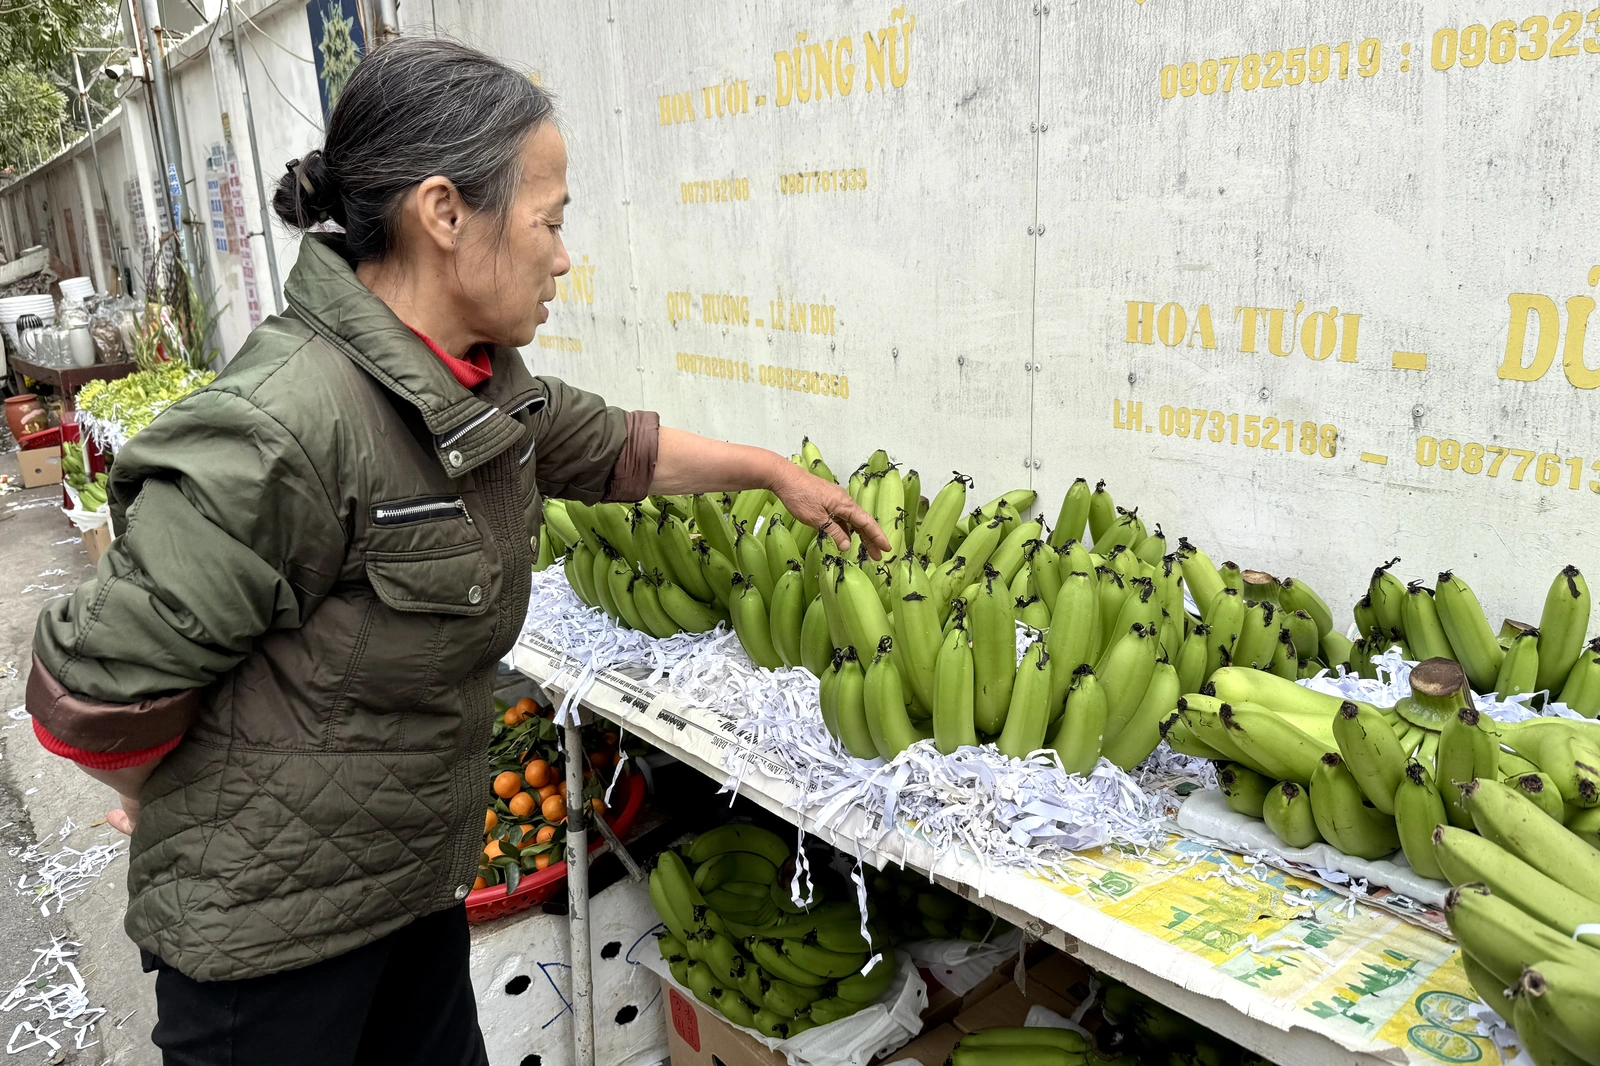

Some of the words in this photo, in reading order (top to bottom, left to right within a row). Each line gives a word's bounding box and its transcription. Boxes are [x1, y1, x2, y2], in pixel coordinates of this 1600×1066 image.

[658, 91, 695, 126] HOA
[702, 78, 749, 119] TƯƠI
[774, 28, 856, 108] DŨNG
[863, 4, 916, 93] NỮ
[1160, 37, 1382, 100] 0987825919
[779, 167, 868, 196] 0987761333
[1124, 300, 1218, 351] HOA
[1233, 300, 1364, 364] TƯƠI
[758, 363, 850, 400] 0963236356
